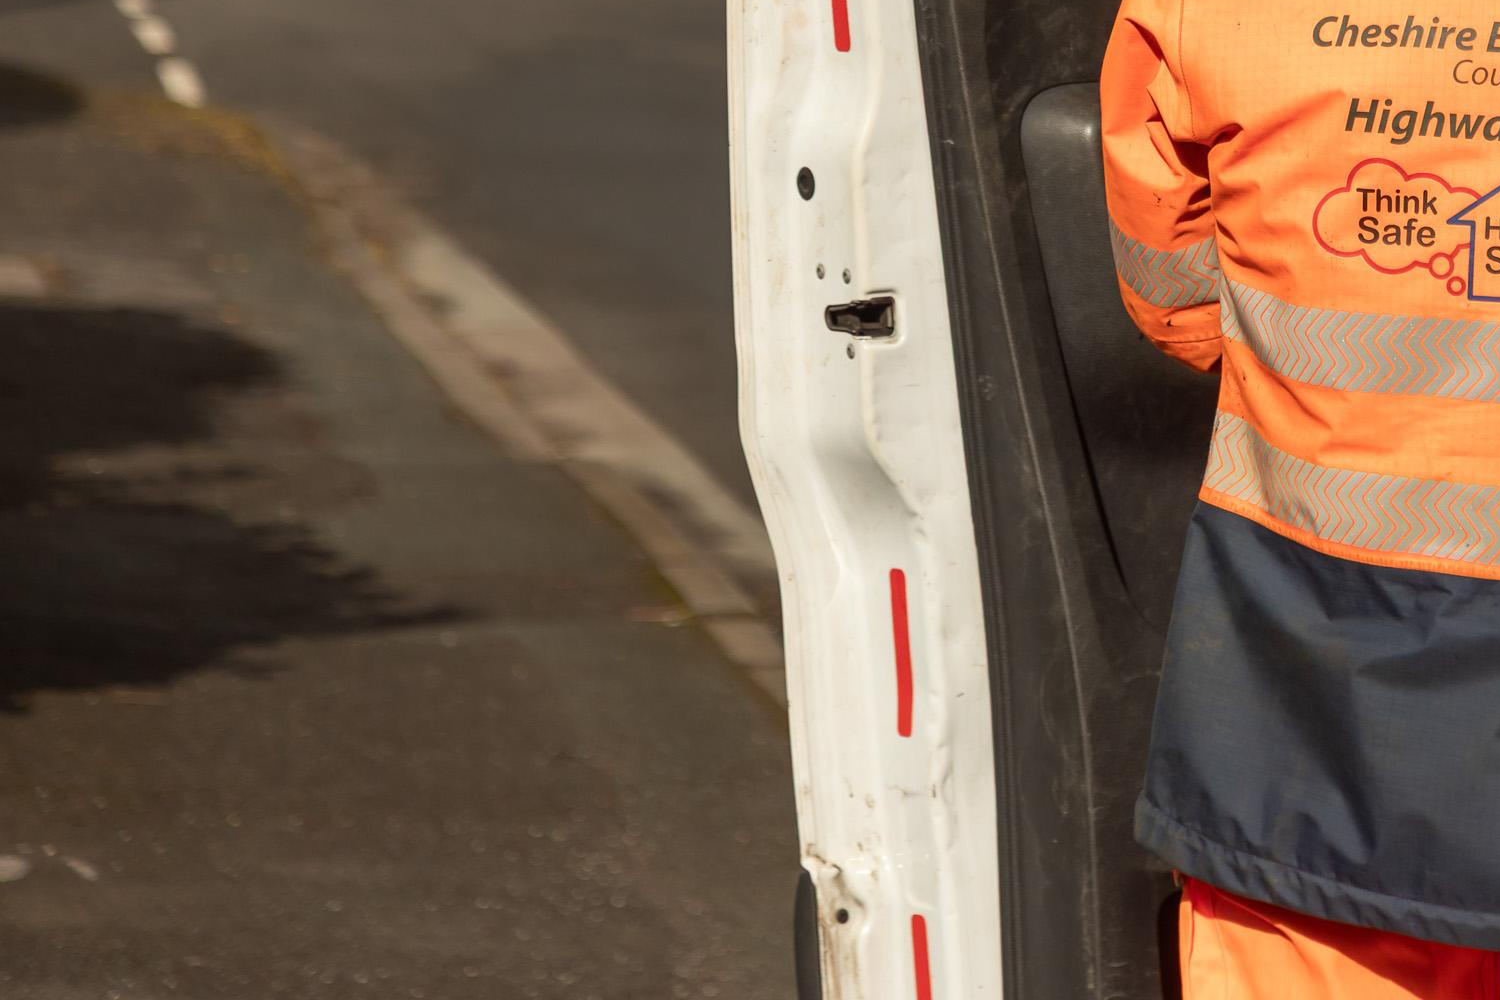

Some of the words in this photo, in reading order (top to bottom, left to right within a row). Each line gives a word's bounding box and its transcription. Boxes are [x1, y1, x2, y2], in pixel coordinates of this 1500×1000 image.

[1312, 14, 1478, 51] Cheshire
[1356, 188, 1438, 216] Think
[1357, 216, 1436, 248] Safe
